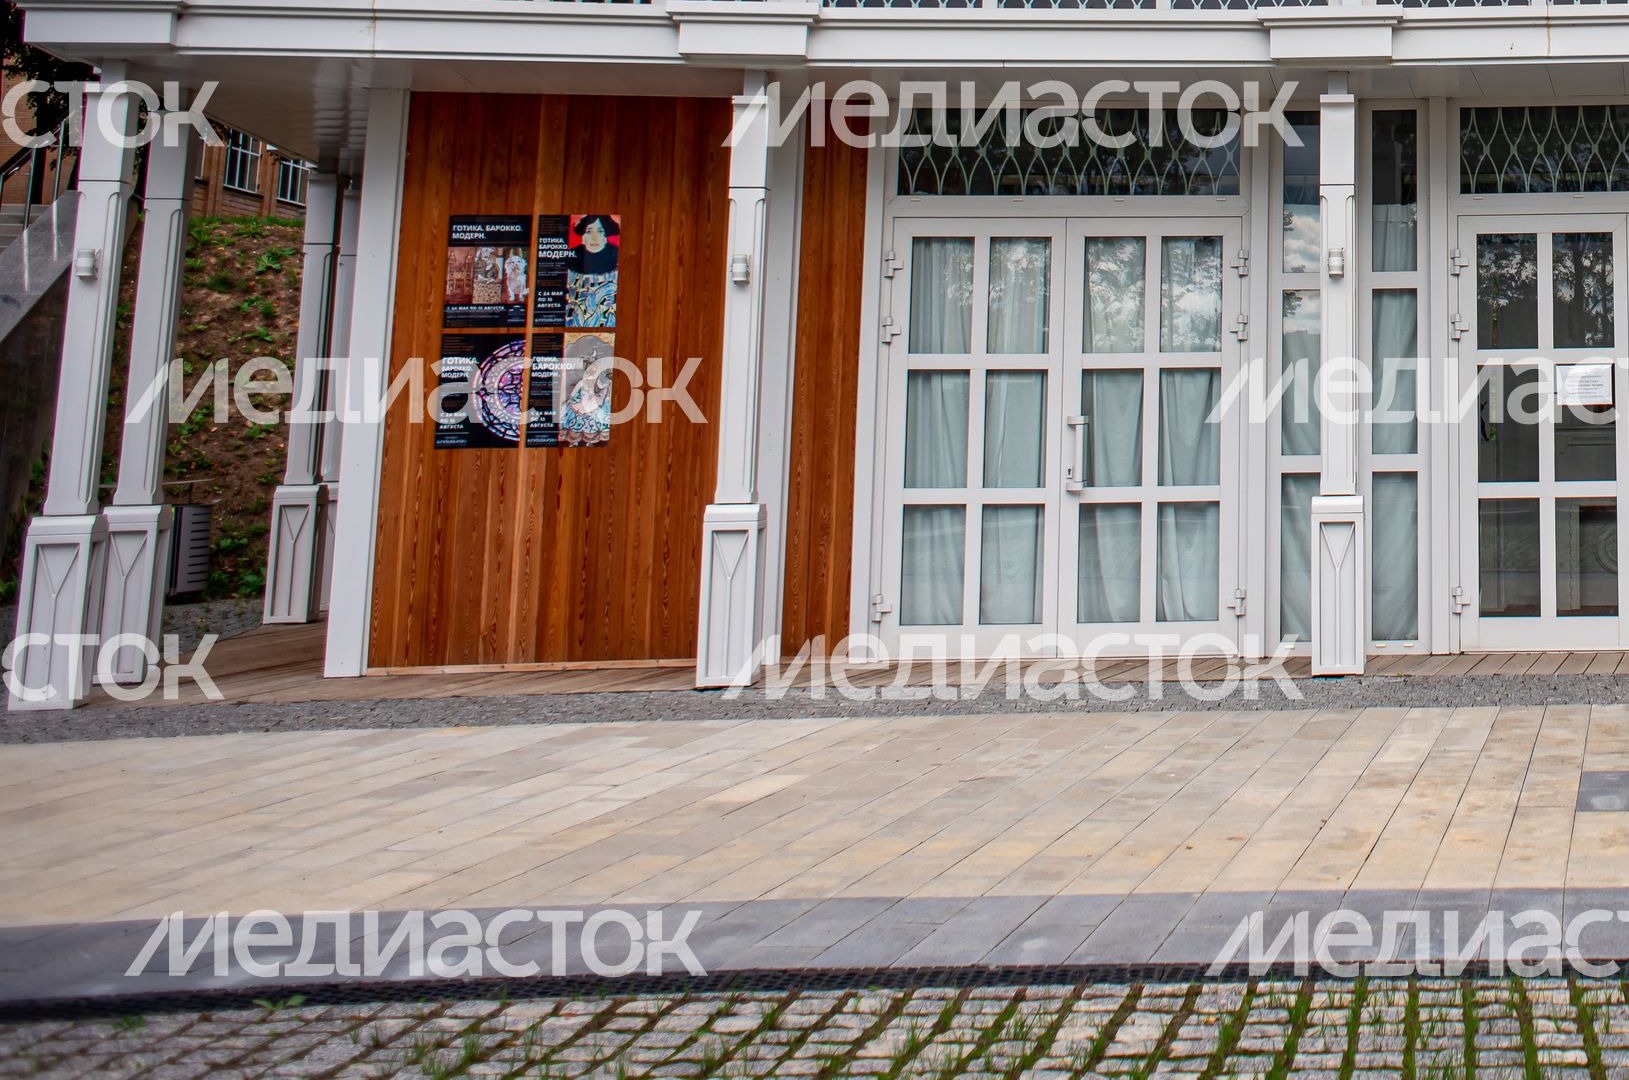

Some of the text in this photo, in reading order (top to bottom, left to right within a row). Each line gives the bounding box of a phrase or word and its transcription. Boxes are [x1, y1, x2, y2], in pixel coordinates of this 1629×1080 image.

[452, 224, 523, 232] ГОТИКА. БАРОККО.
[452, 232, 487, 240] МОДЕРН.
[538, 250, 577, 259] МОДЕРН.
